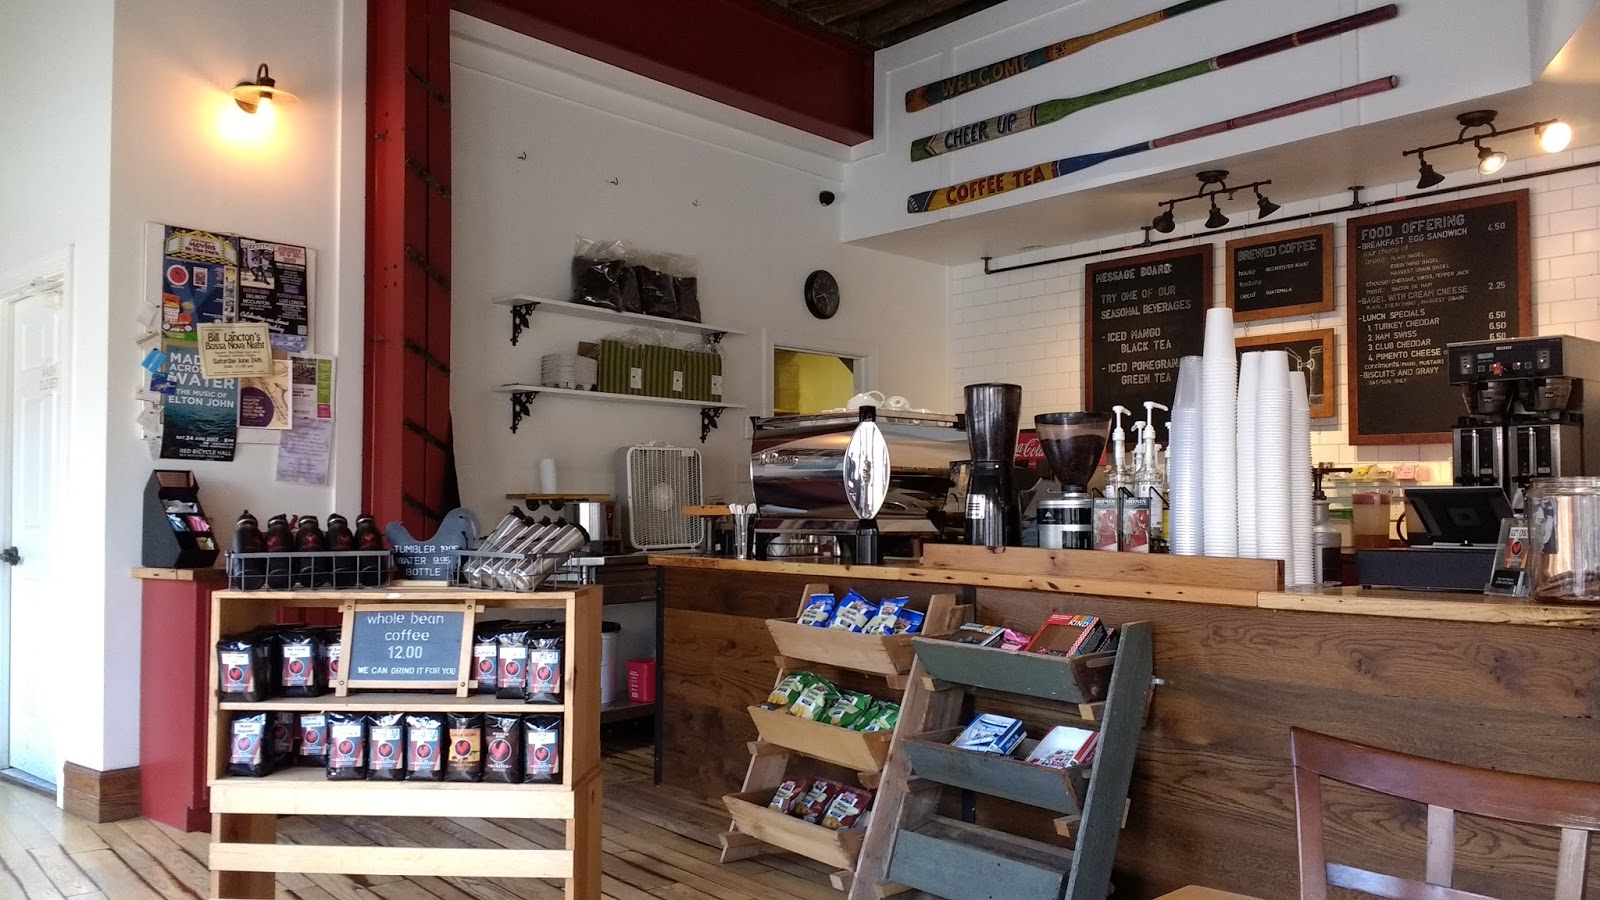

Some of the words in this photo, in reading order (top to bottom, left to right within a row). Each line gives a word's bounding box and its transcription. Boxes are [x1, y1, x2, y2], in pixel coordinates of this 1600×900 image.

[942, 54, 1029, 97] WELCOME
[945, 119, 989, 150] CHEER
[997, 112, 1017, 133] UP
[945, 172, 1004, 206] COFFEE
[1012, 166, 1045, 186] TEA
[1361, 225, 1392, 240] FOOD
[1402, 214, 1464, 234] OFFERING
[1408, 234, 1424, 243] EGG
[1427, 228, 1468, 240] SANDWICH
[1488, 222, 1506, 231] 4.50
[1237, 246, 1276, 262] BREWED
[1278, 239, 1316, 255] COFFEE
[1096, 268, 1136, 283] MESSAGE
[1101, 294, 1117, 304] TRY
[1121, 291, 1138, 301] ONE
[1142, 288, 1153, 299] OF
[1158, 286, 1176, 296] OUR
[1266, 287, 1293, 295] GUATEMALA
[1388, 292, 1406, 301] WITH
[1408, 289, 1434, 299] CREAM
[1437, 285, 1468, 296] CHEESE
[1488, 281, 1506, 290] 2.25
[1101, 306, 1140, 320] SEASONAL
[1143, 300, 1191, 314] BEVERAGES
[1390, 308, 1426, 320] SPECIALS
[1488, 311, 1506, 320] 6.50
[1374, 321, 1403, 331] TURKEY
[1406, 317, 1440, 327] CHEDDAR
[1489, 321, 1507, 330] 6.50
[208, 332, 220, 342] Bill
[224, 332, 261, 342] Lancton's
[1131, 327, 1160, 340] MANGO
[1375, 332, 1390, 341] HAM
[1394, 330, 1417, 339] SWISS
[1489, 332, 1506, 340] 6.50
[205, 342, 226, 350] Bossa
[1121, 342, 1148, 353] BLACK
[1154, 339, 1172, 349] TEA
[1375, 342, 1394, 351] CLUB
[1396, 338, 1431, 348] CHEDDAR
[1376, 351, 1408, 360] PIMENTO
[1411, 348, 1441, 357] CHEESE
[1131, 358, 1179, 372] POMEGRAN
[1415, 367, 1439, 375] GRAVY
[1121, 374, 1150, 386] GREEN
[1154, 372, 1171, 383] TEA
[168, 396, 203, 406] ELTON
[206, 399, 234, 408] JOHN
[393, 545, 436, 554] TUMBLER
[397, 556, 426, 565] WATER
[433, 556, 451, 565] 9.95
[406, 568, 441, 576] BOTTLE
[366, 612, 405, 624] whole
[410, 612, 444, 624] bean
[1068, 620, 1090, 628] KIND
[384, 629, 430, 642] coffee
[388, 646, 423, 659] 12.00
